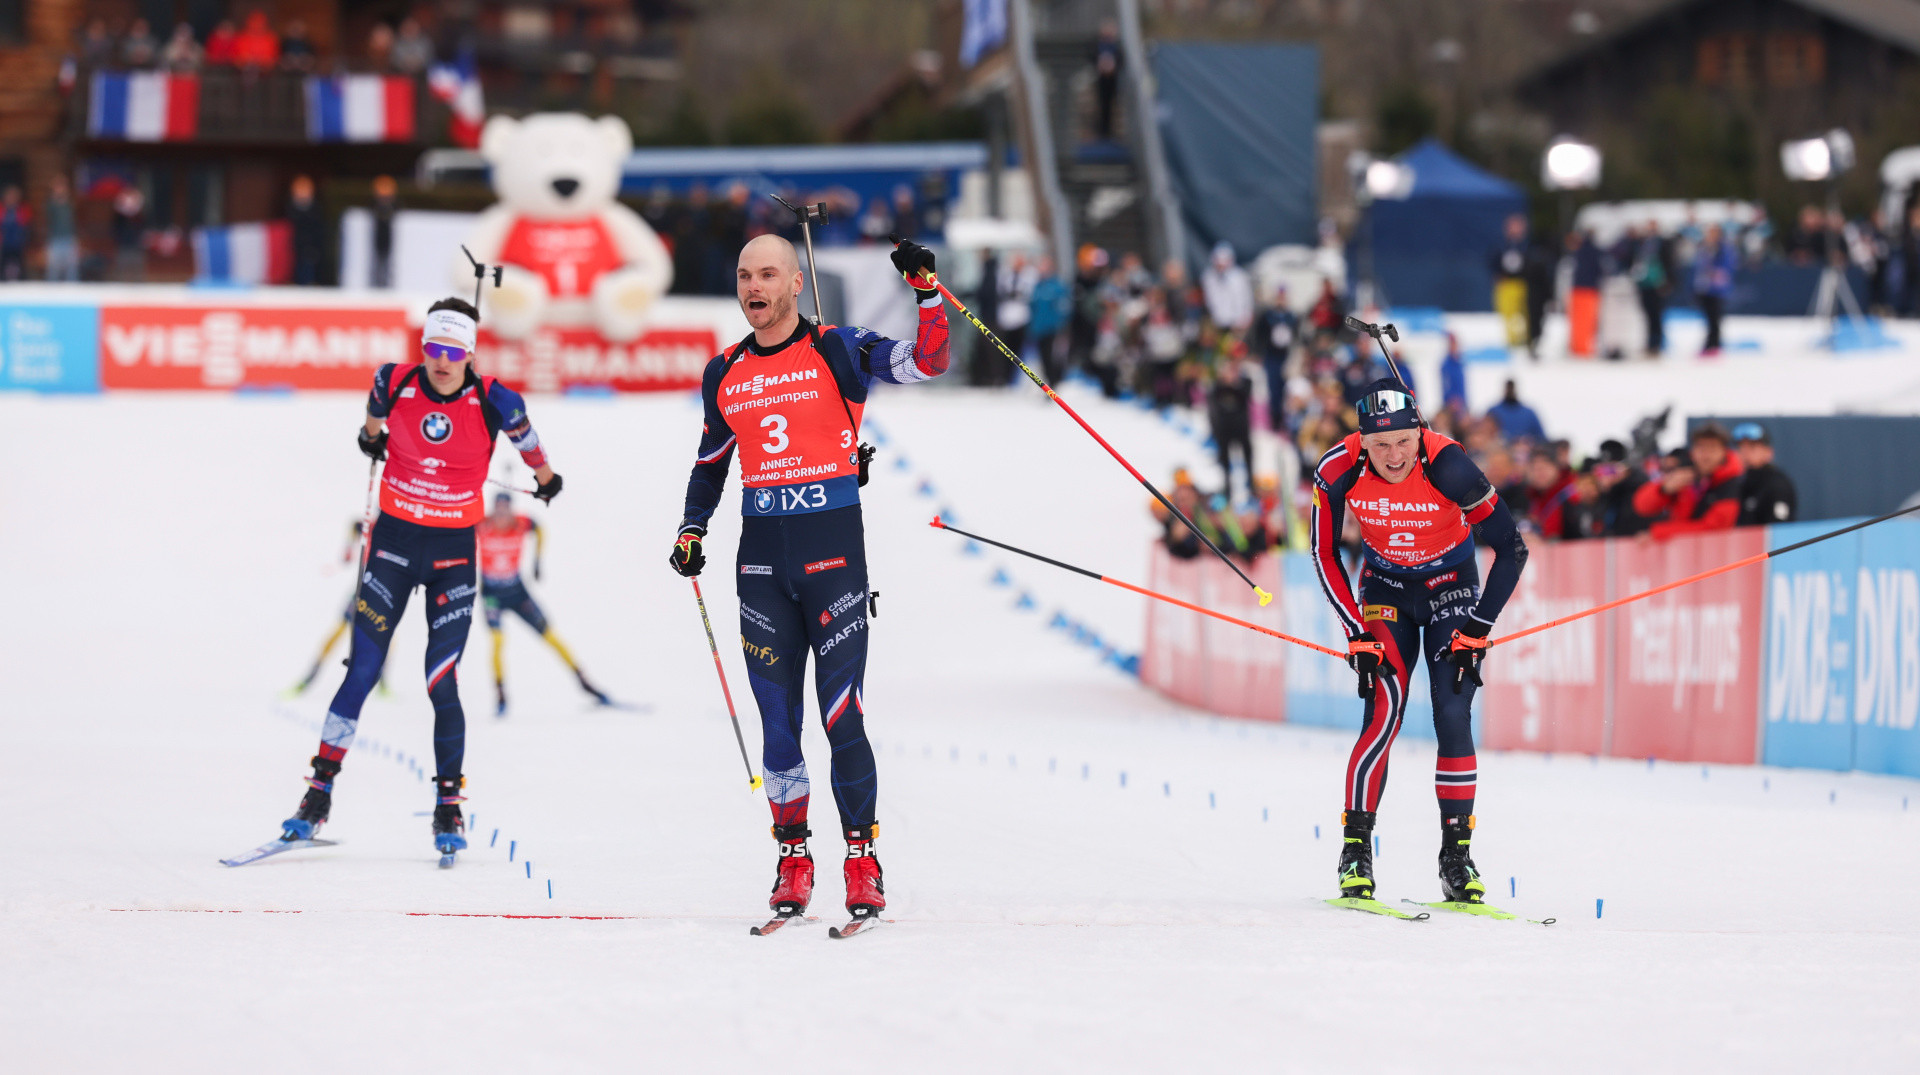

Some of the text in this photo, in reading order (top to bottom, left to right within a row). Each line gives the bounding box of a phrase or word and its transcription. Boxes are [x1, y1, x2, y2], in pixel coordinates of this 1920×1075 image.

[104, 312, 409, 387] VIESSMANN
[725, 368, 818, 396] VIESSMANN
[724, 389, 819, 416] Wärmepumpen
[759, 413, 790, 454] 3
[840, 429, 853, 449] 3
[750, 462, 838, 482] GRAND-BORNAND
[760, 456, 803, 471] ANNECY
[781, 484, 827, 511] iX3
[1349, 498, 1440, 517] VIESSMANN
[394, 498, 463, 519] VIESSMANN
[1360, 516, 1433, 529] Heat pumps
[1388, 532, 1415, 547] 2
[806, 559, 844, 571] VIESSMANN
[1429, 573, 1455, 587] MENY
[828, 591, 854, 612] CAISSE
[357, 599, 389, 632] omfy
[819, 620, 858, 656] CRAFT
[1768, 571, 1831, 724] DKB
[740, 634, 780, 666] omfy
